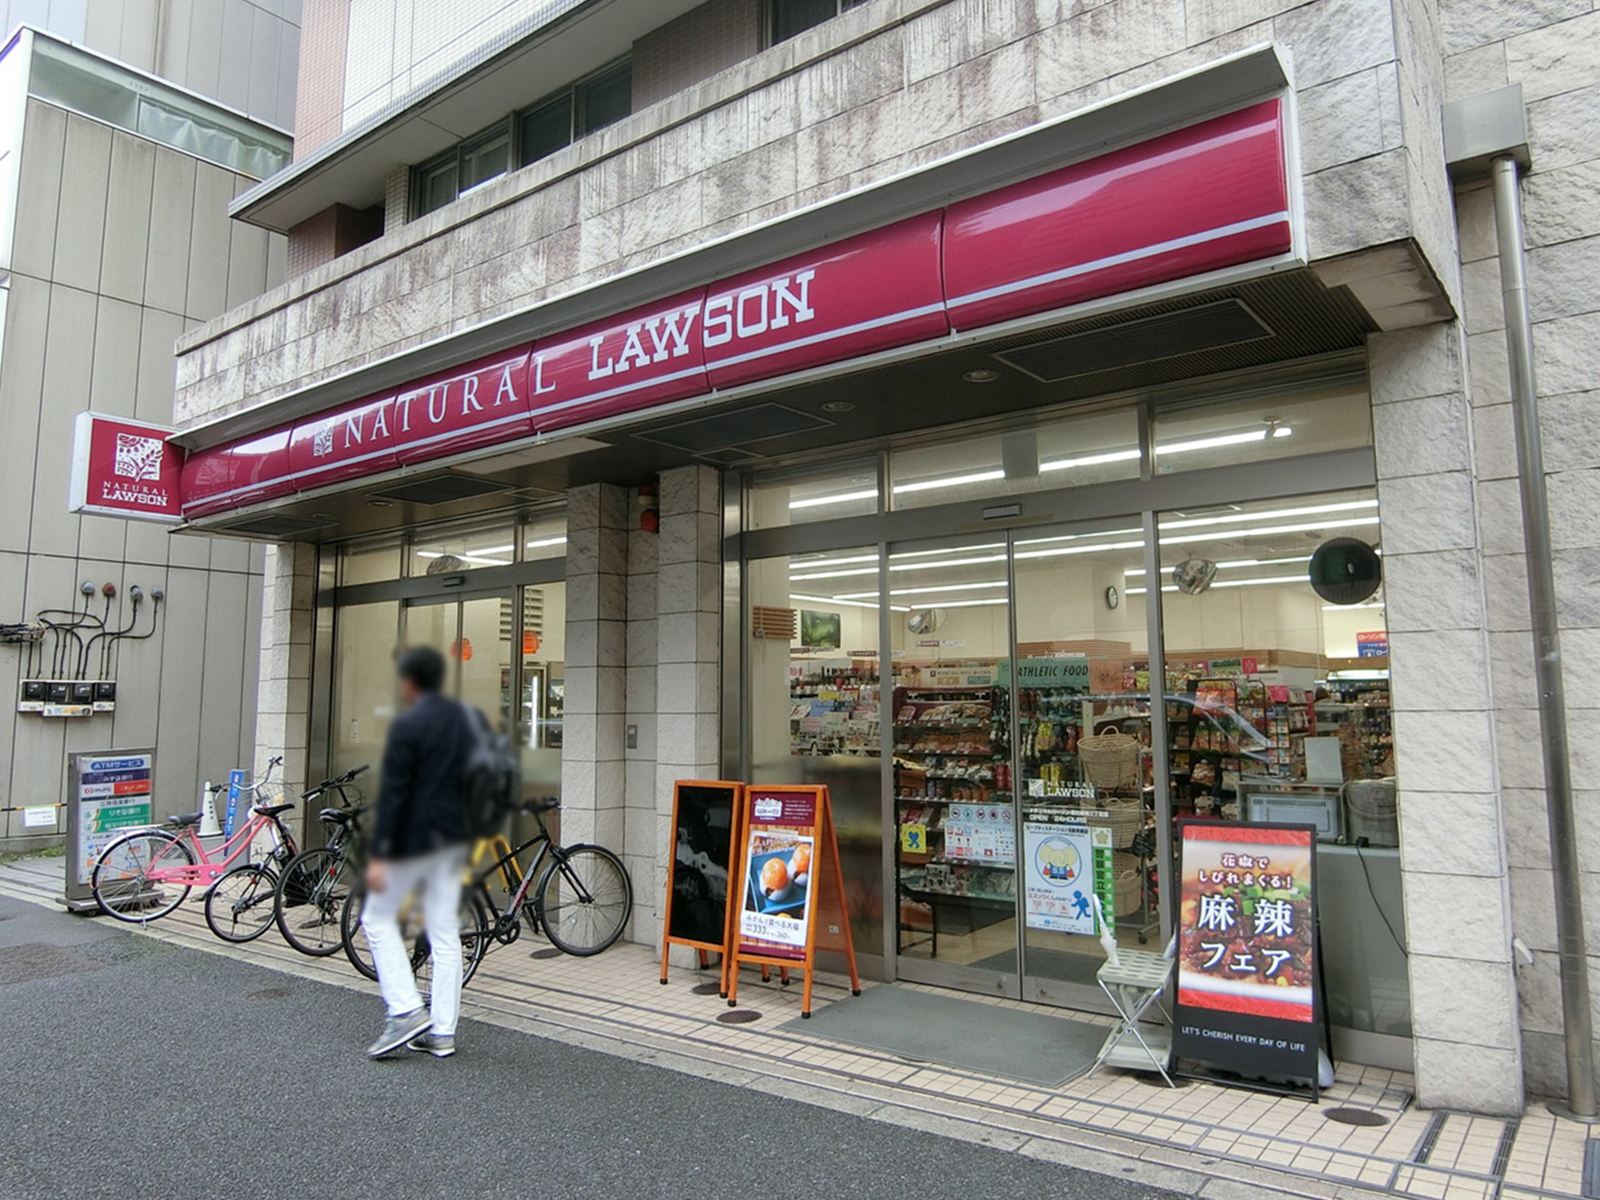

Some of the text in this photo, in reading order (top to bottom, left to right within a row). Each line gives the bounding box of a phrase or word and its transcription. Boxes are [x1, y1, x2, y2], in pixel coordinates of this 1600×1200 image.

[343, 269, 817, 449] NATURAL LAWSON
[103, 480, 168, 496] NATURAL
[102, 488, 168, 507] LAWSON
[1063, 665, 1089, 676] FOOD
[93, 759, 142, 769] ATMサービス
[1047, 780, 1095, 789] NATURAL
[1047, 787, 1095, 798] LAWSON
[108, 807, 142, 817] りそな銀行
[1029, 814, 1049, 822] OPEN
[1221, 853, 1270, 869] 花椒で
[1198, 869, 1293, 889] しびれまくる！
[746, 914, 800, 931] みかんで食べる大福
[1200, 941, 1292, 976] フェア
[1181, 1026, 1306, 1052] LET'S CHERISH EVERY DAY OF LIFE
